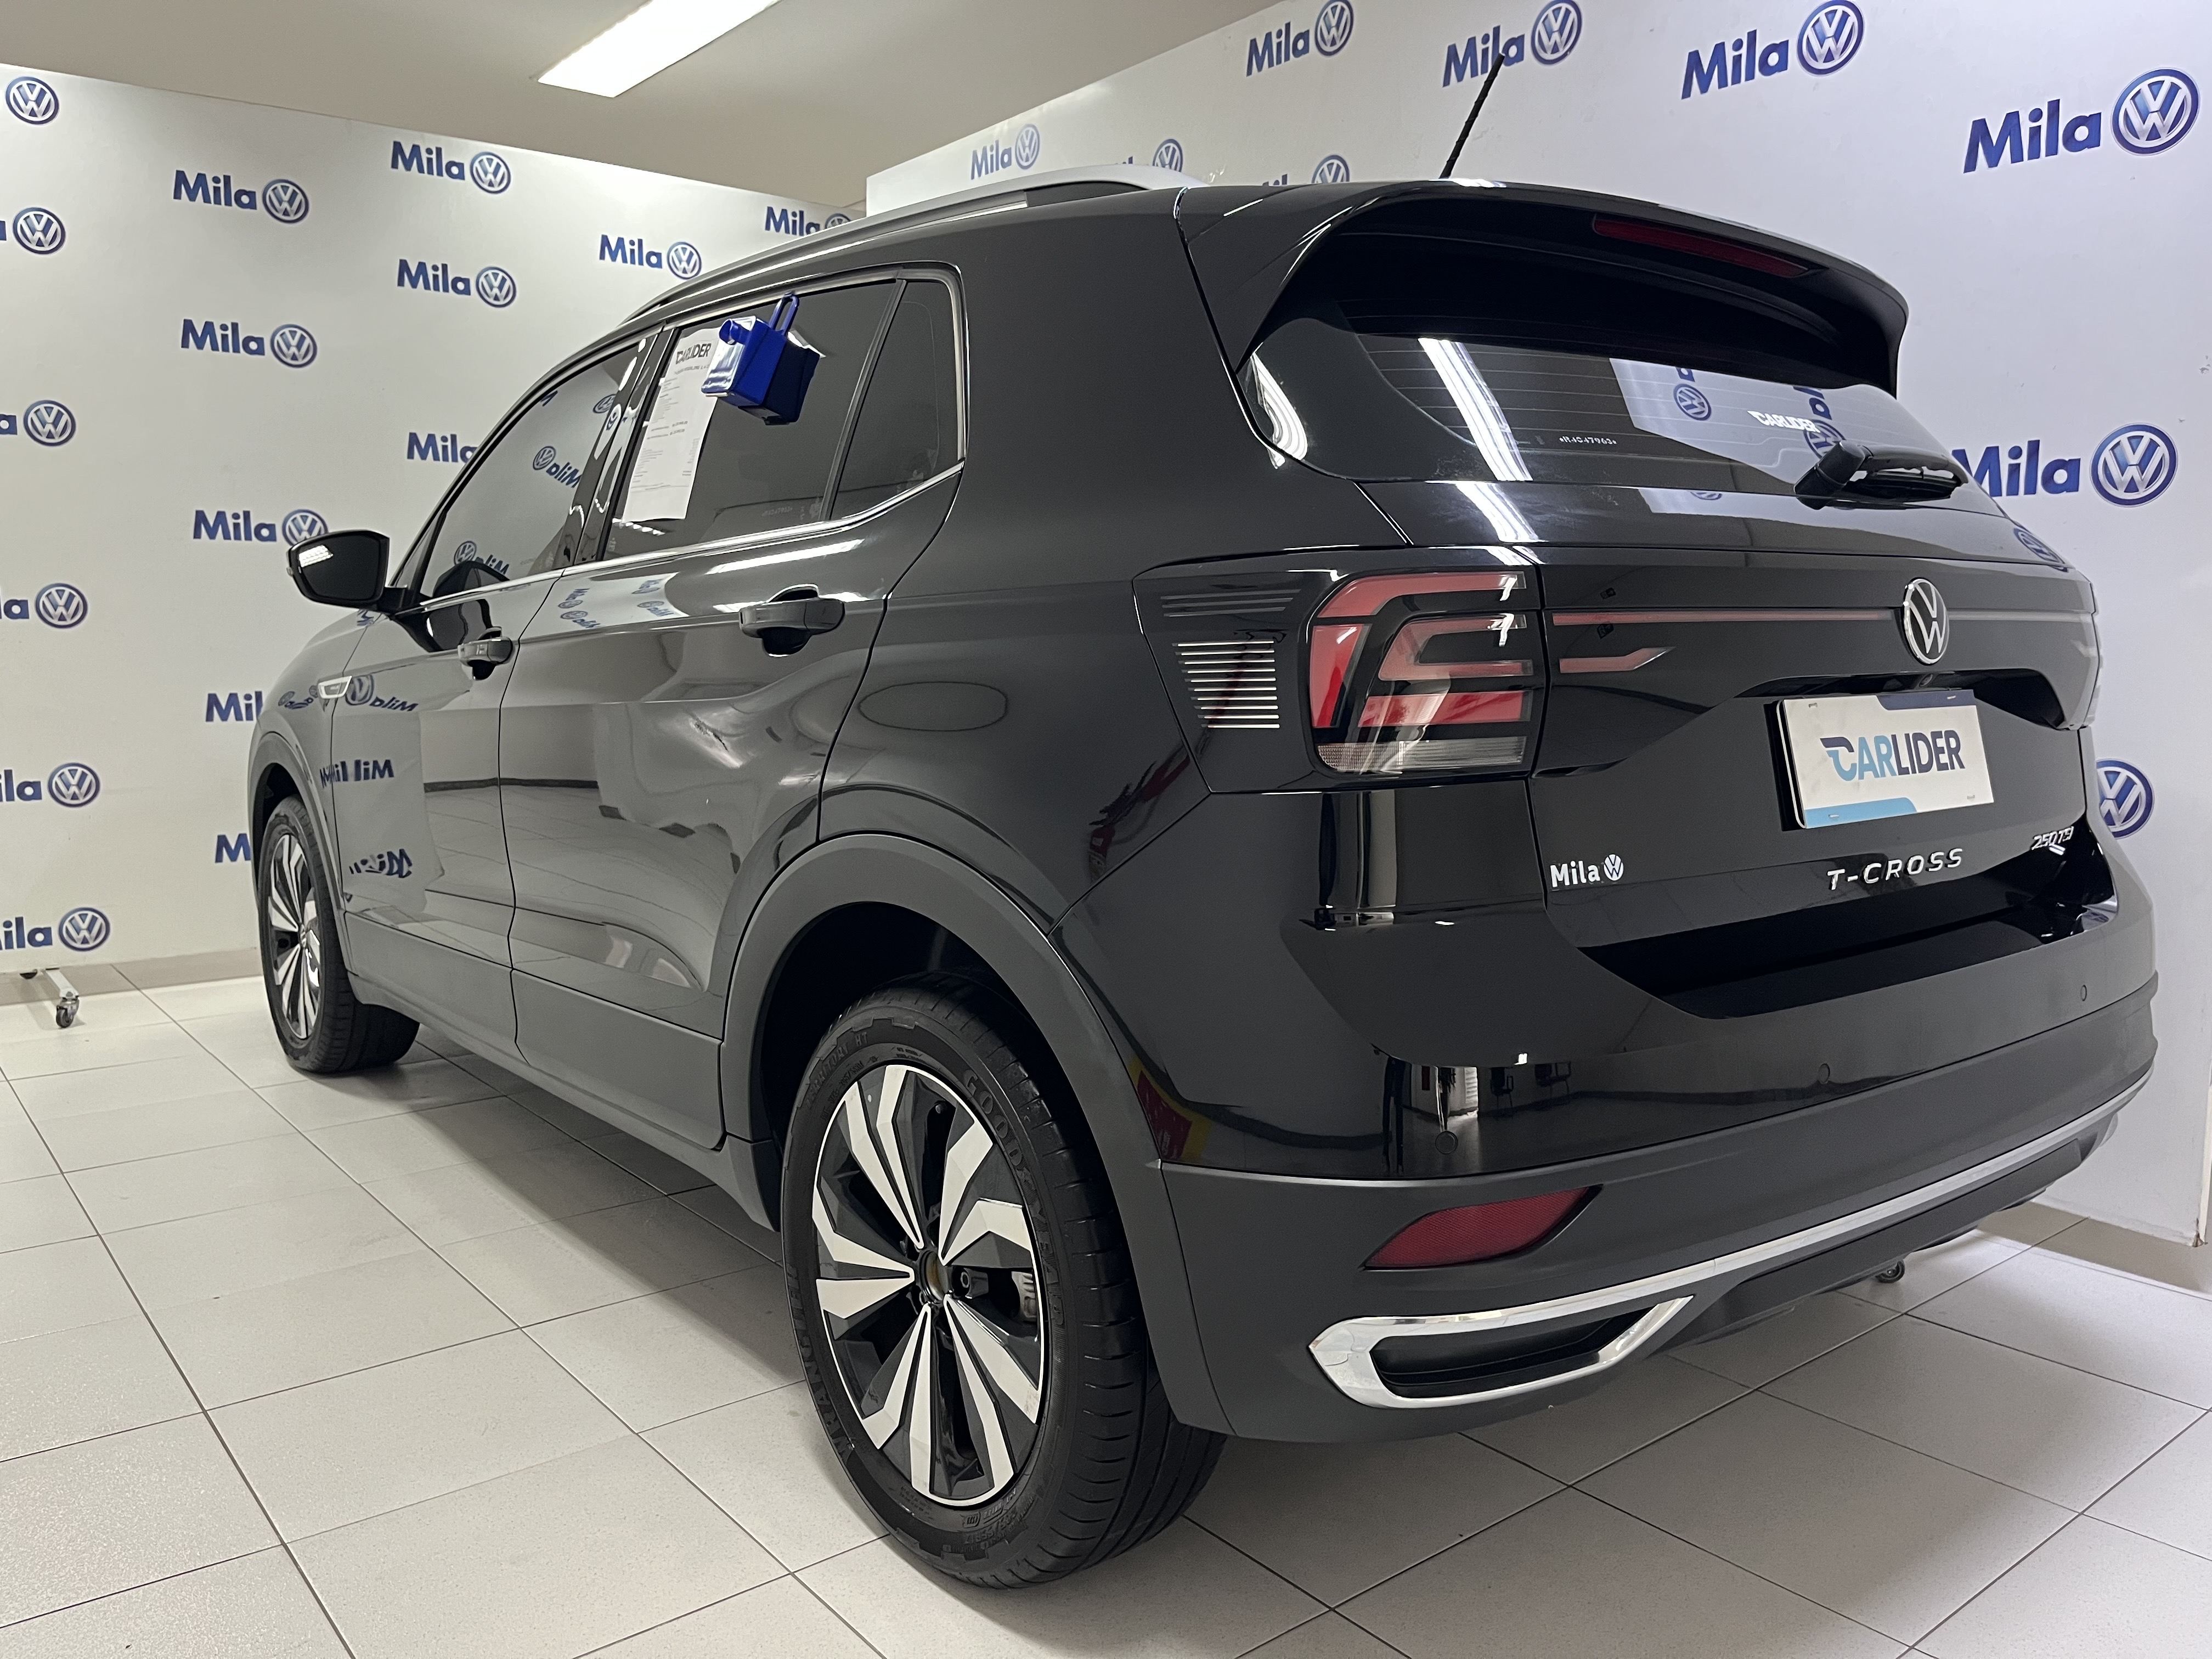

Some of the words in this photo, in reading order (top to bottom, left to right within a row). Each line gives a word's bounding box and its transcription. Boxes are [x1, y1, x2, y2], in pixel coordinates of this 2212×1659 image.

[1246, 21, 1310, 77] Mila
[1442, 25, 1525, 88] Mila
[1681, 30, 1788, 99] Mila
[1963, 99, 2102, 173] Mila
[391, 141, 465, 180] Mila
[970, 140, 1012, 180] Mila
[173, 170, 257, 210] Mila
[765, 207, 820, 236] Mila
[600, 235, 663, 269] Mila
[397, 259, 471, 296] Mila
[181, 319, 266, 356] Mila
[1952, 439, 2081, 497] Mila
[193, 510, 277, 542] Mila
[206, 691, 262, 723] Mil
[1820, 730, 1966, 781] CARLIDER
[1550, 860, 1601, 888] Mila
[1827, 849, 1963, 891] T-CROSS
[0, 916, 53, 951] ila
